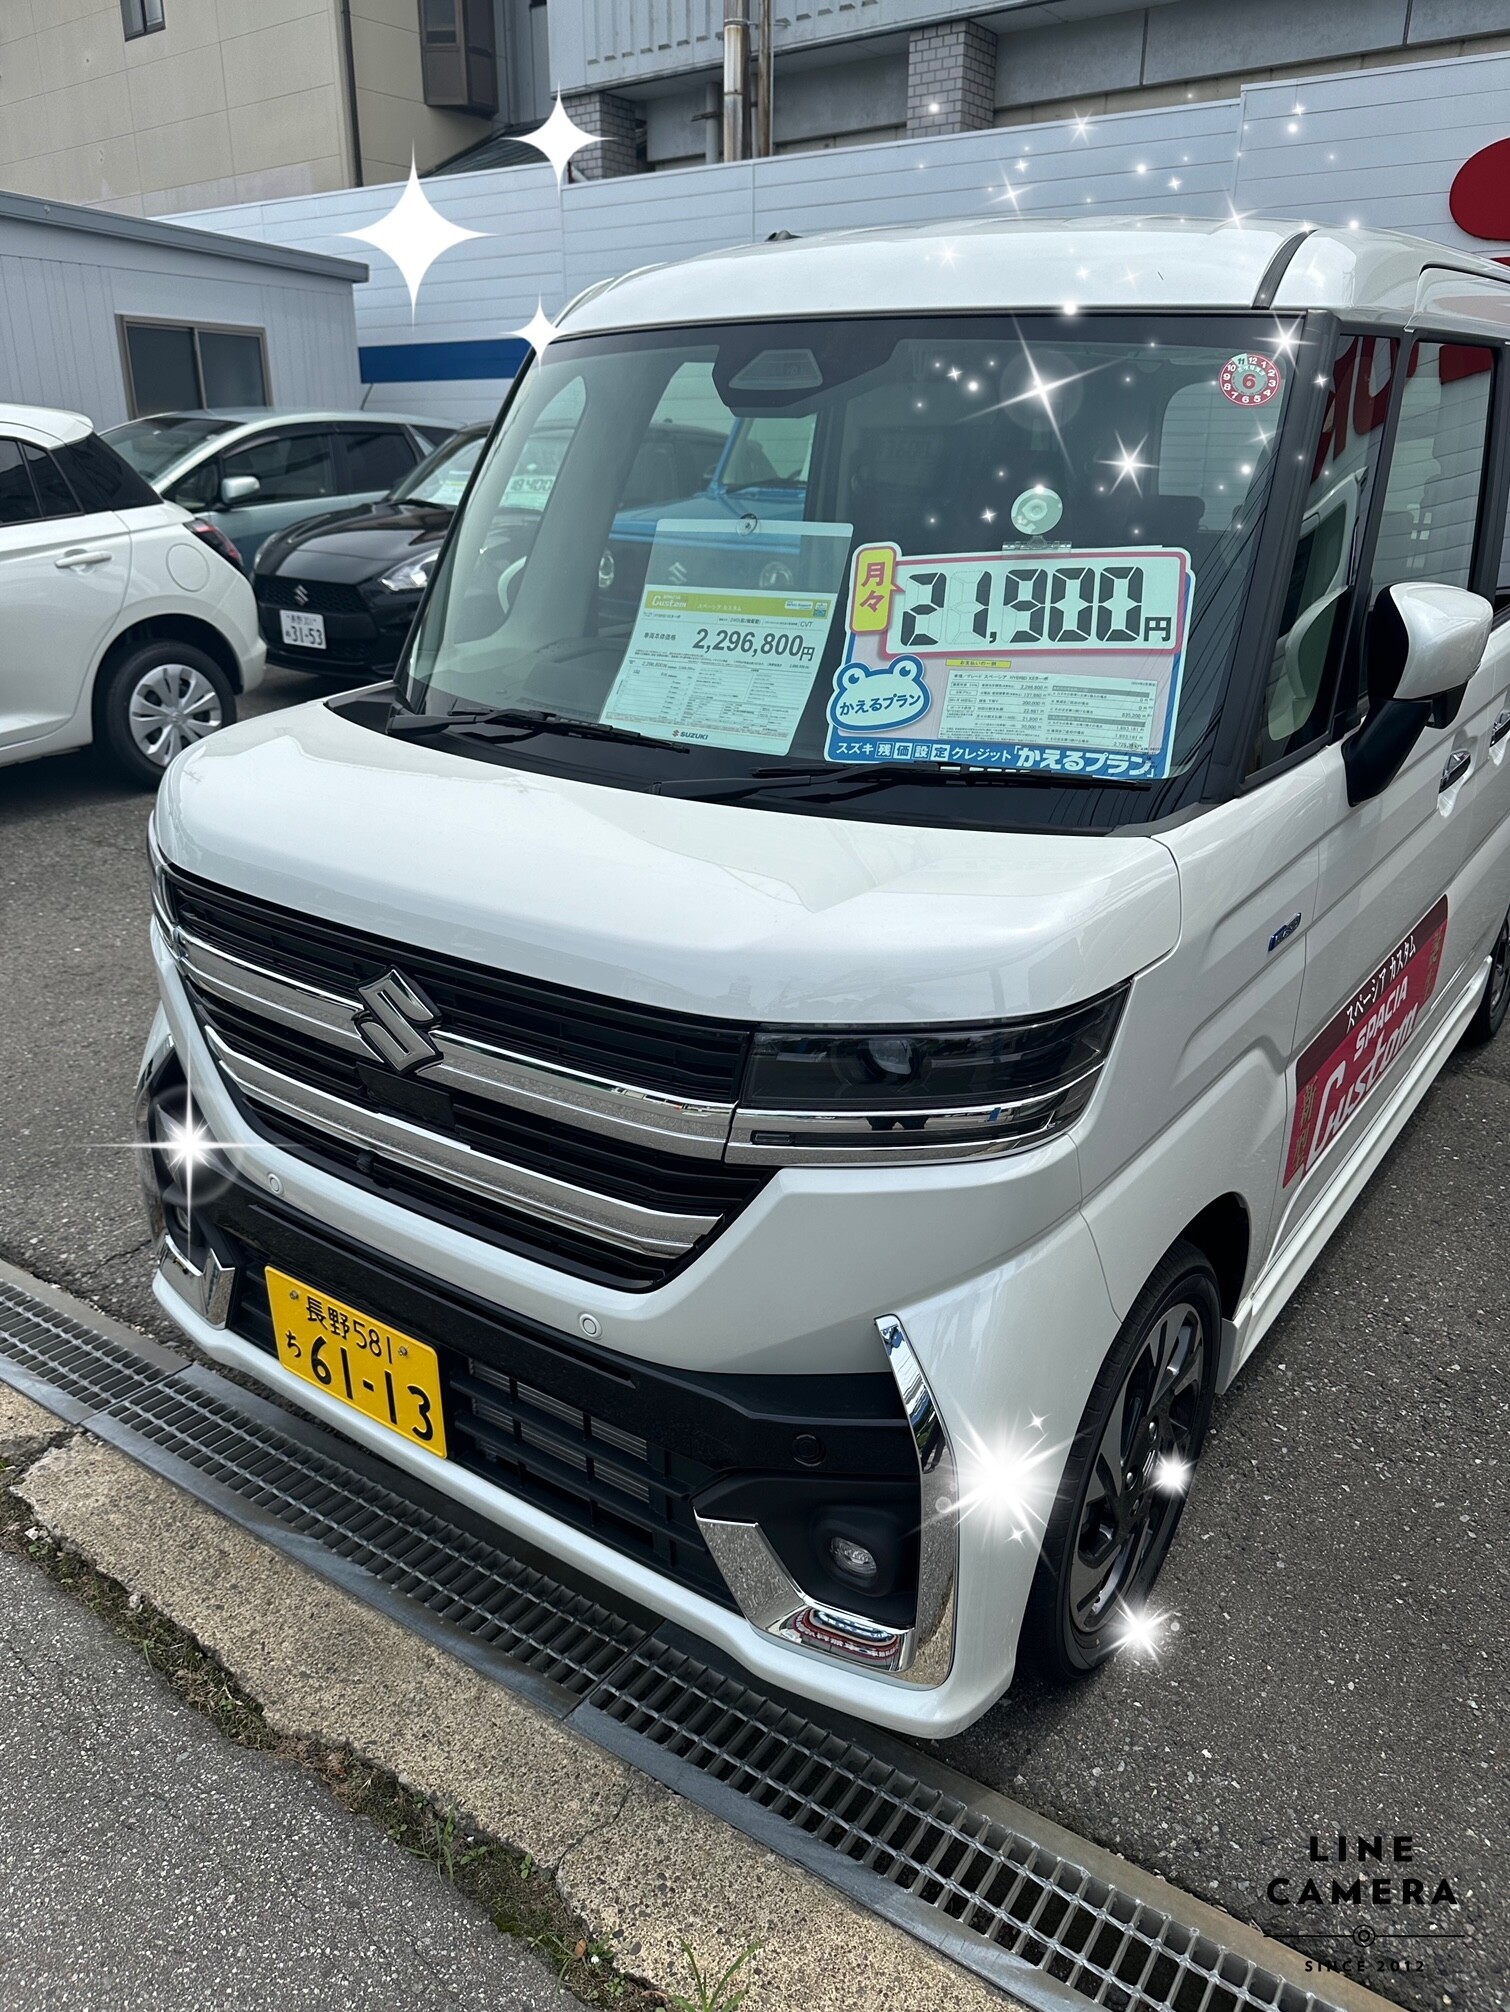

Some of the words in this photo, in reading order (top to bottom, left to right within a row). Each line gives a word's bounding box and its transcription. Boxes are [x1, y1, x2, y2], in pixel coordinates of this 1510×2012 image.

[1238, 357, 1245, 365] 11
[1227, 364, 1236, 372] 10
[1267, 369, 1275, 377] 2
[1242, 373, 1256, 389] 6
[1268, 379, 1276, 387] 3
[1223, 383, 1231, 391] 8
[1231, 391, 1239, 399] 7
[1263, 389, 1271, 397] 4
[1241, 395, 1249, 403] 6
[1253, 395, 1261, 403] 5
[859, 561, 887, 613] 月々
[651, 595, 687, 608] Custom
[692, 628, 815, 662] 2,296,800円
[839, 692, 922, 715] かえるプラン
[680, 731, 709, 741] SUZUKI
[1346, 967, 1386, 1034] スペーシア
[1388, 935, 1416, 981] カスタム
[1353, 975, 1409, 1062] SPACIA
[1305, 1002, 1419, 1172] Custom
[285, 1328, 302, 1358] ち
[310, 1335, 434, 1441] 61-13
